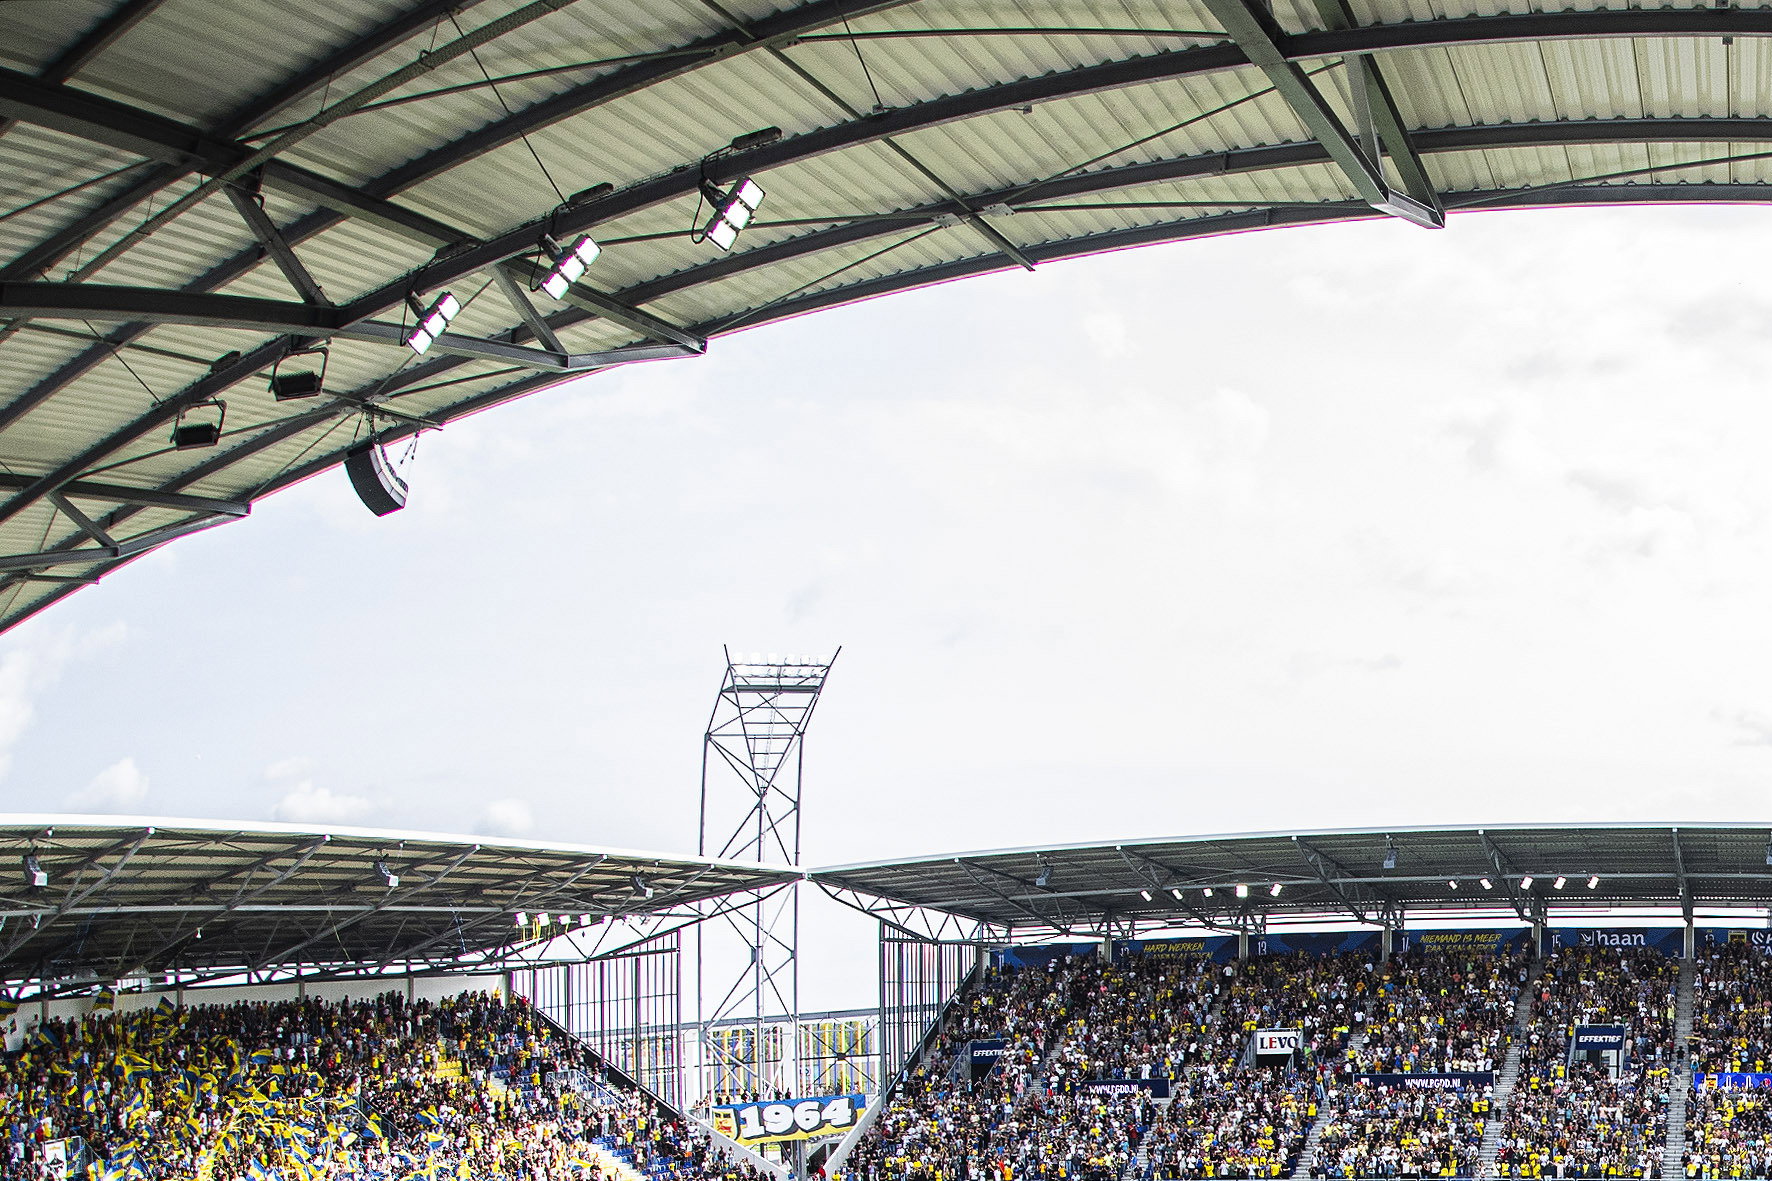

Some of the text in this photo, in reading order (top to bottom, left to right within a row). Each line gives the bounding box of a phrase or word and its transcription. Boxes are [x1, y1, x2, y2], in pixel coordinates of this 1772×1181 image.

[1597, 930, 1646, 946] haan
[1168, 942, 1204, 952] WERKEN
[1260, 1037, 1298, 1049] LEVO
[1579, 1035, 1622, 1043] EFFEKTIEF
[740, 1098, 852, 1138] 1964
